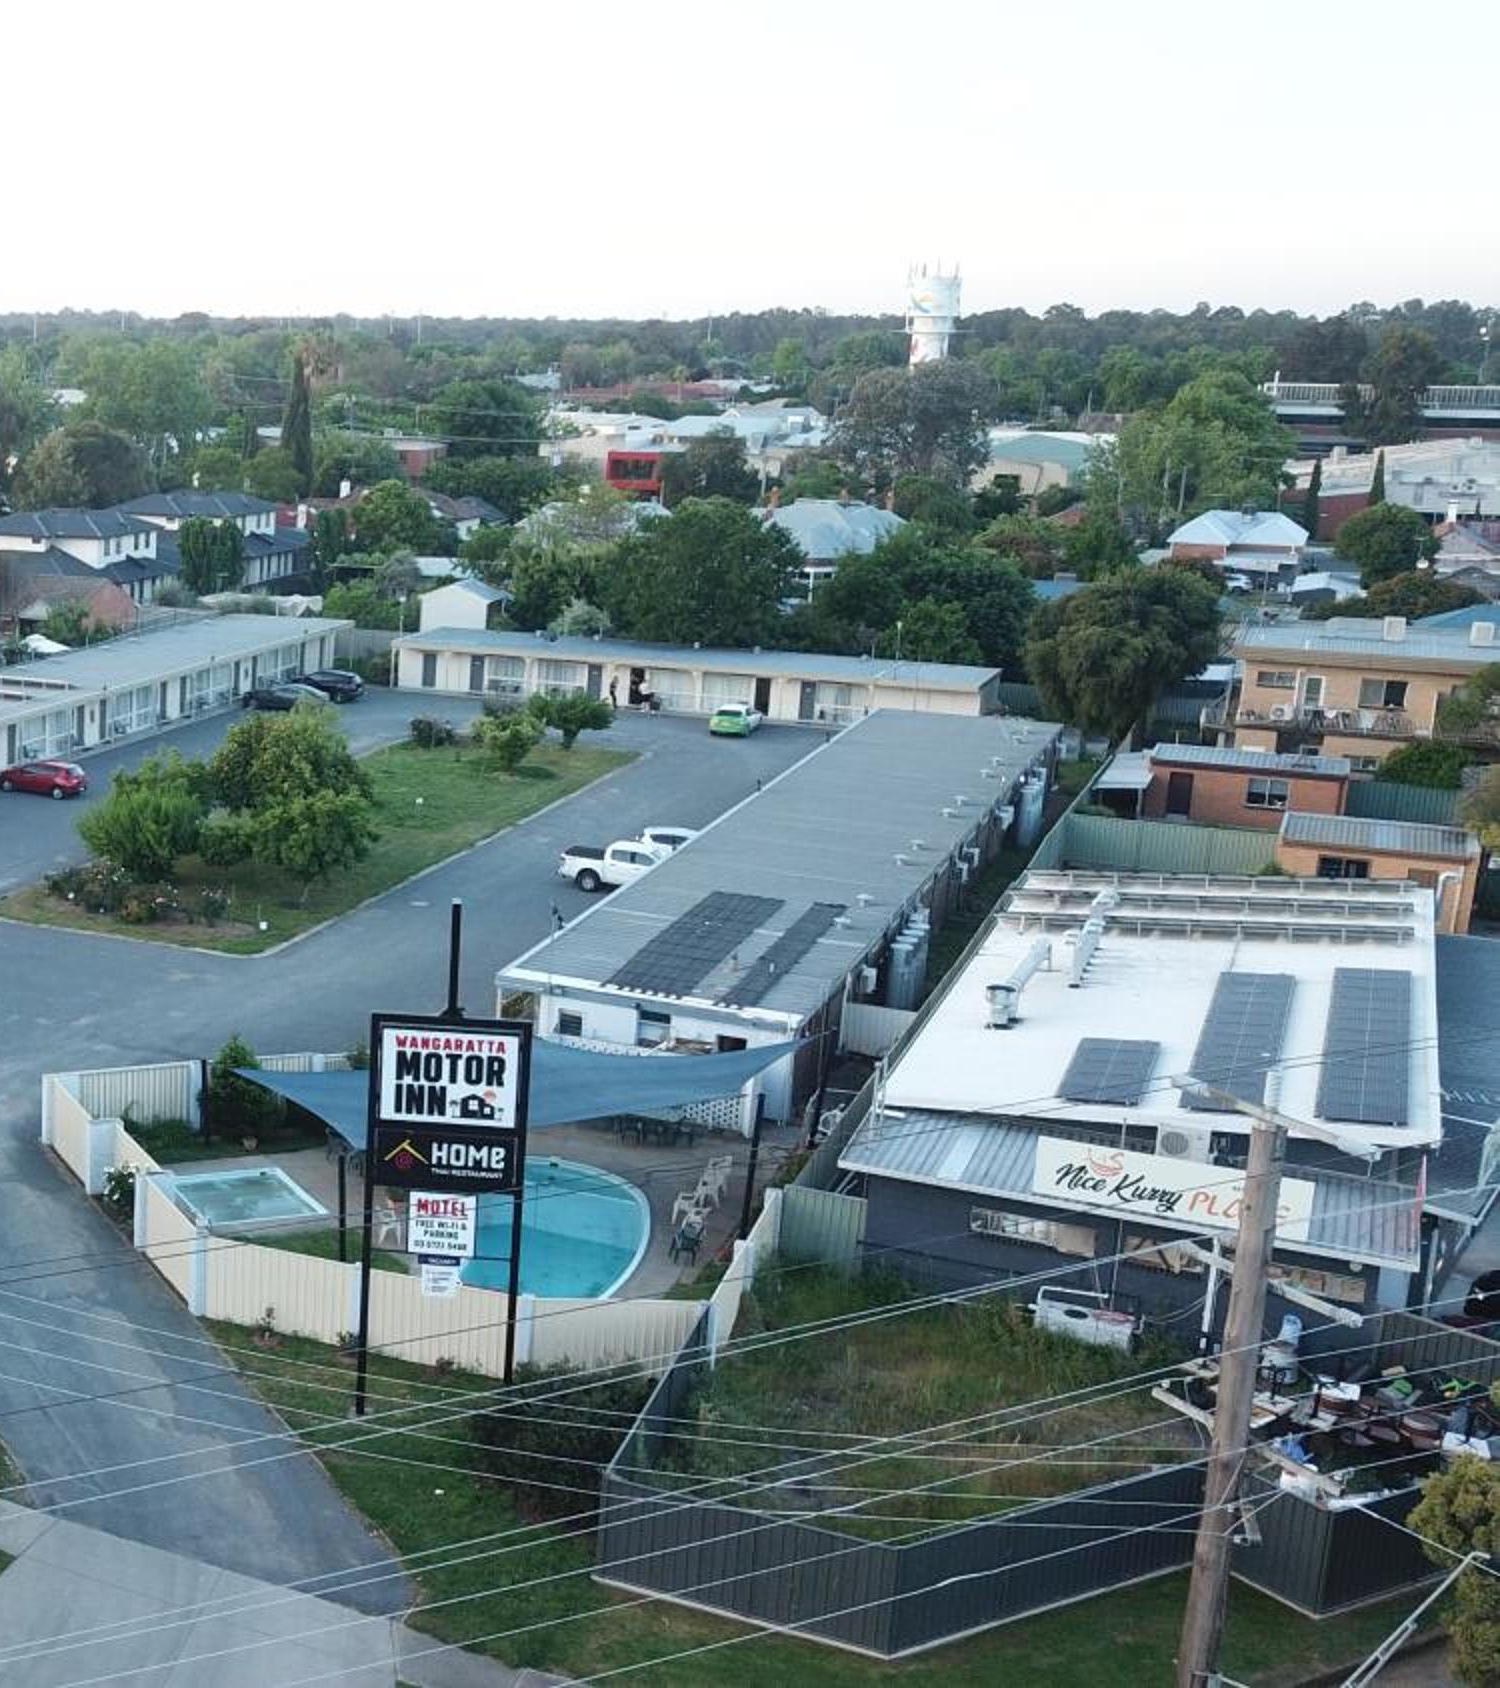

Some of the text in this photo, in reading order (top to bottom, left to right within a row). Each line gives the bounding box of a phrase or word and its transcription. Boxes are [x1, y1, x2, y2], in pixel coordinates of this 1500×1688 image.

[395, 1035, 506, 1055] WANGARATTA
[395, 1050, 506, 1088] MOTOR
[394, 1083, 448, 1117] INN
[431, 1141, 506, 1169] HOME
[1056, 1163, 1107, 1192] Nice
[1107, 1173, 1183, 1213] Kurry
[417, 1198, 469, 1217] MOTEL
